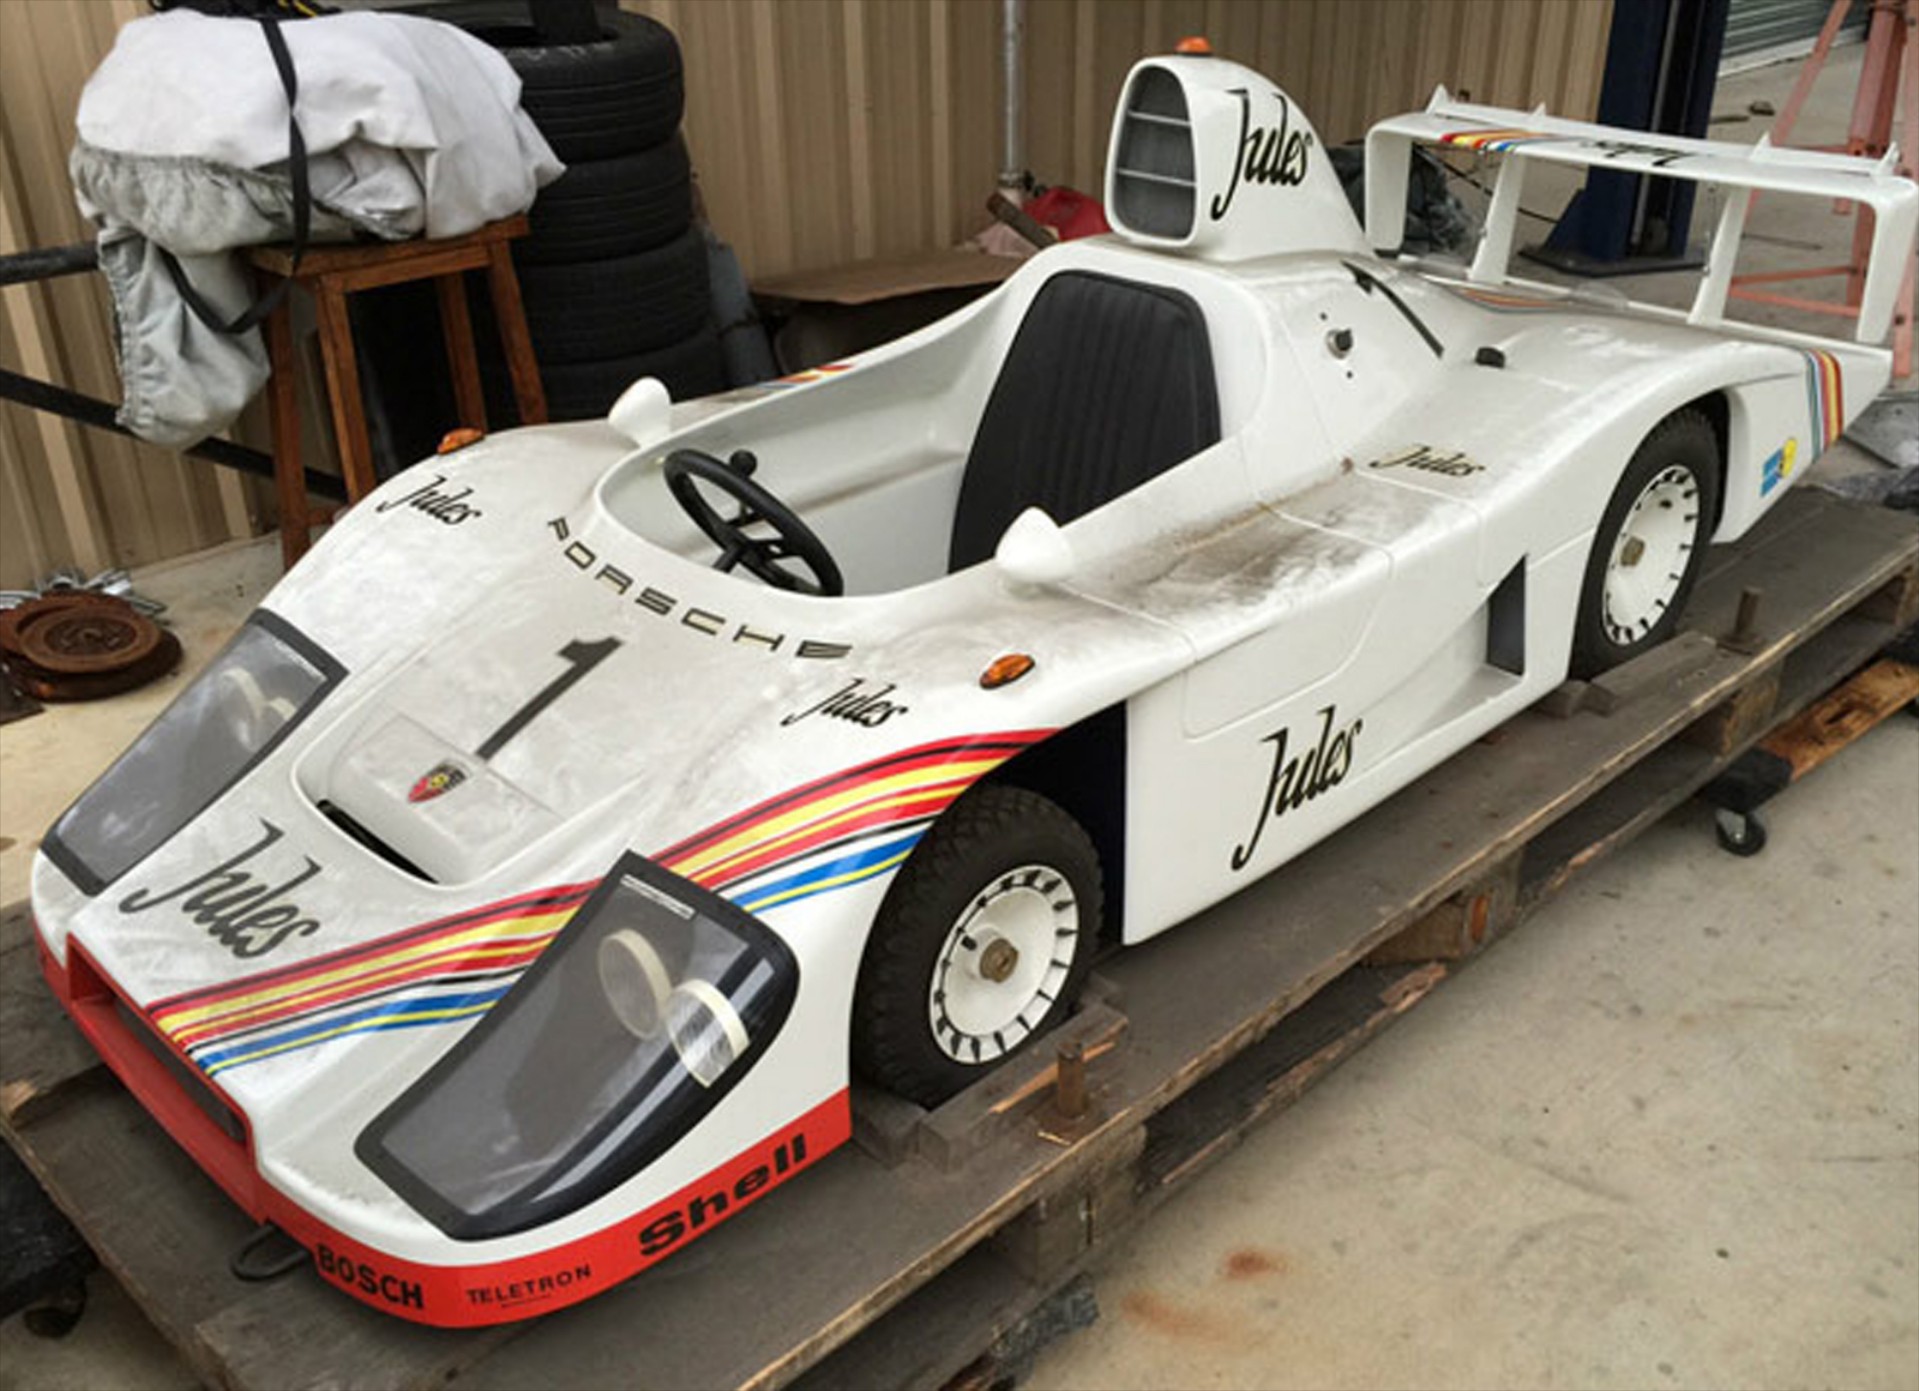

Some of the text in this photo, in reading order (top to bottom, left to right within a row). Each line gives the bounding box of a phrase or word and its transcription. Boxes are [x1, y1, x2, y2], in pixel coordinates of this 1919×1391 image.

[1211, 88, 1313, 221] Jules
[376, 474, 482, 525] Jules
[1368, 445, 1485, 477] Jules
[548, 517, 853, 659] PORSCHE
[476, 636, 623, 762] 1
[780, 678, 908, 728] Jules
[1231, 704, 1362, 871] Jules
[119, 817, 322, 959] Jules
[638, 1133, 806, 1256] Shell
[317, 1244, 424, 1311] BOSCH
[466, 1264, 591, 1305] TELETRON
